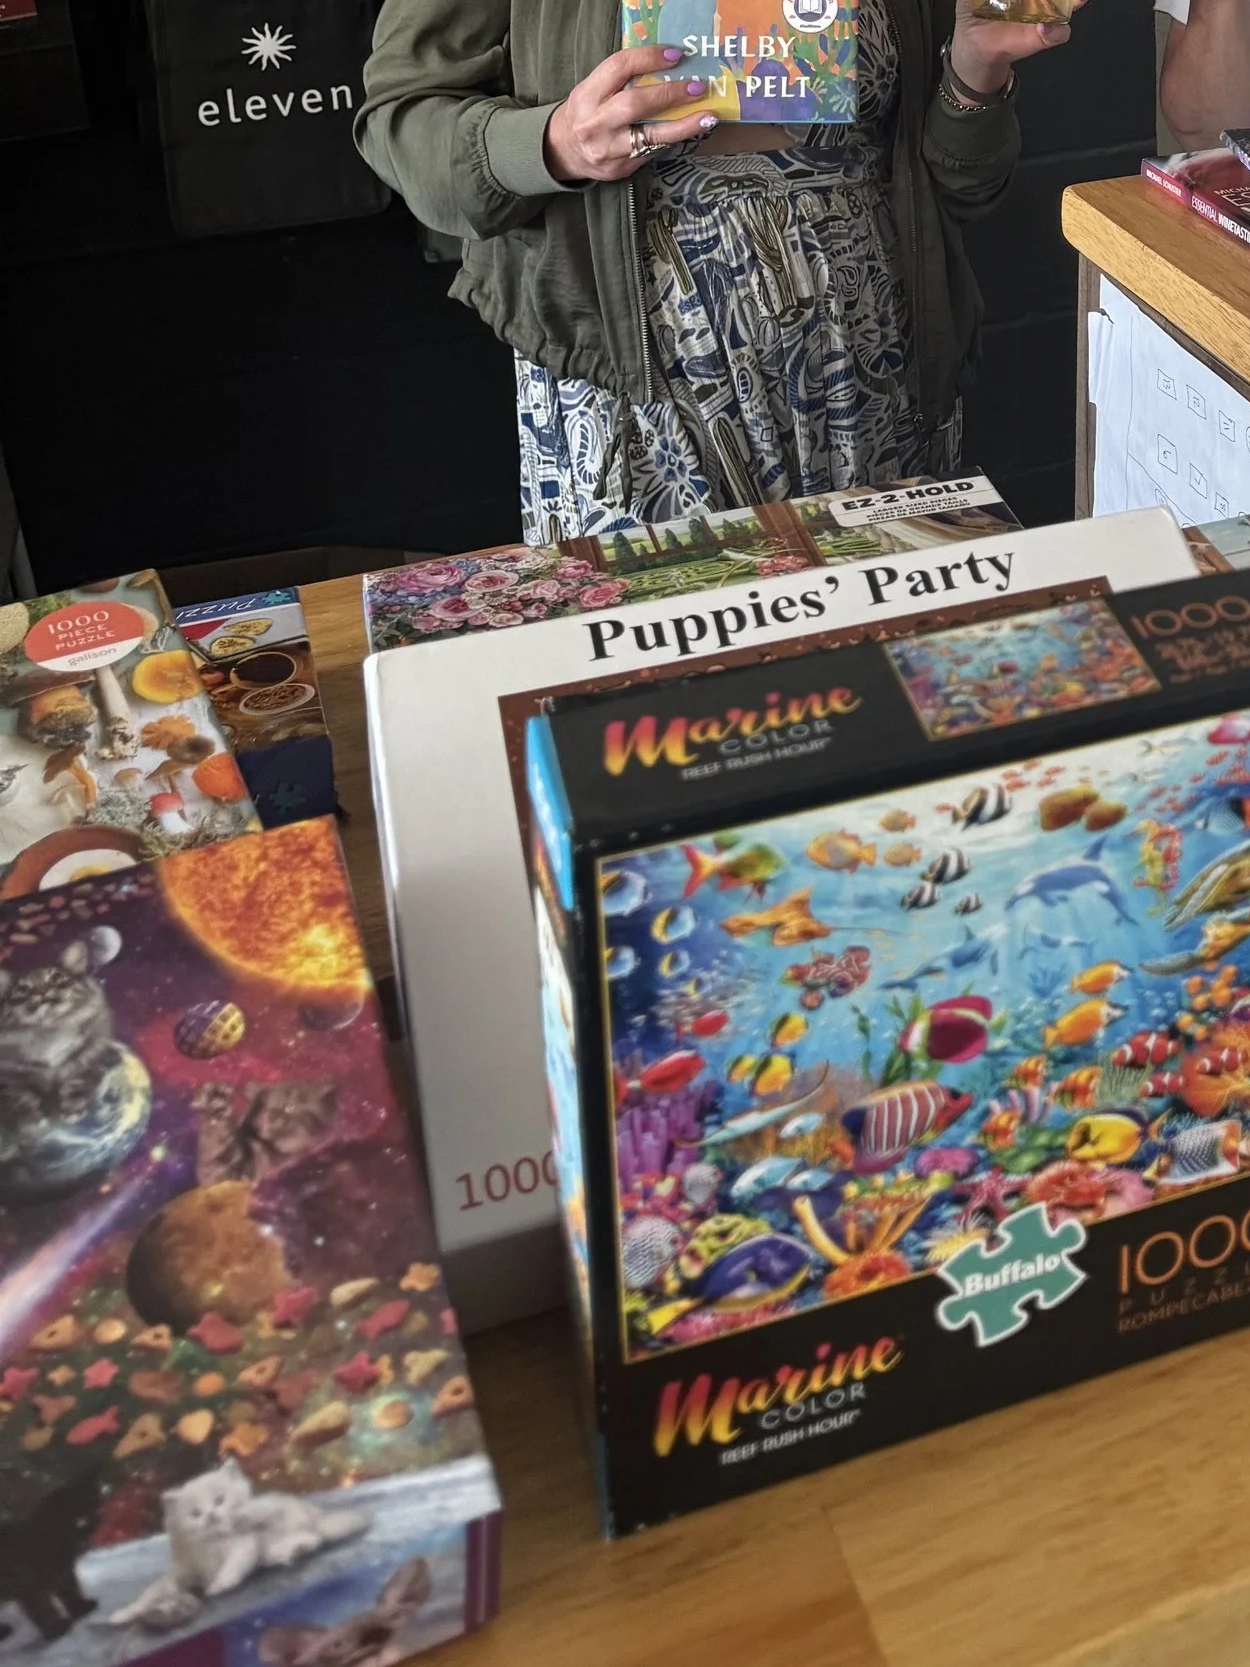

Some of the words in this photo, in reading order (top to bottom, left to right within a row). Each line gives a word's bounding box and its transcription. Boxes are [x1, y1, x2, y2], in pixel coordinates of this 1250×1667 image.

[682, 35, 795, 58] SHELBY
[745, 76, 811, 98] PELT
[199, 84, 354, 127] eleven
[1191, 196, 1218, 223] ESSENTIAL
[842, 481, 975, 511] EZ-2-HOLD
[862, 550, 1015, 606] Party
[47, 610, 110, 634] 1000
[57, 623, 108, 641] PIECE
[55, 630, 116, 651] PUZZLE
[604, 686, 864, 778] Marine
[717, 717, 835, 756] COLOR
[681, 761, 720, 781] REEF
[725, 750, 772, 770] RUSH
[963, 1252, 1062, 1298] Buffalo
[653, 1335, 904, 1457] Marine
[760, 1381, 867, 1431] COLOR
[719, 1438, 761, 1467] REEF
[763, 1427, 806, 1455] RUSH
